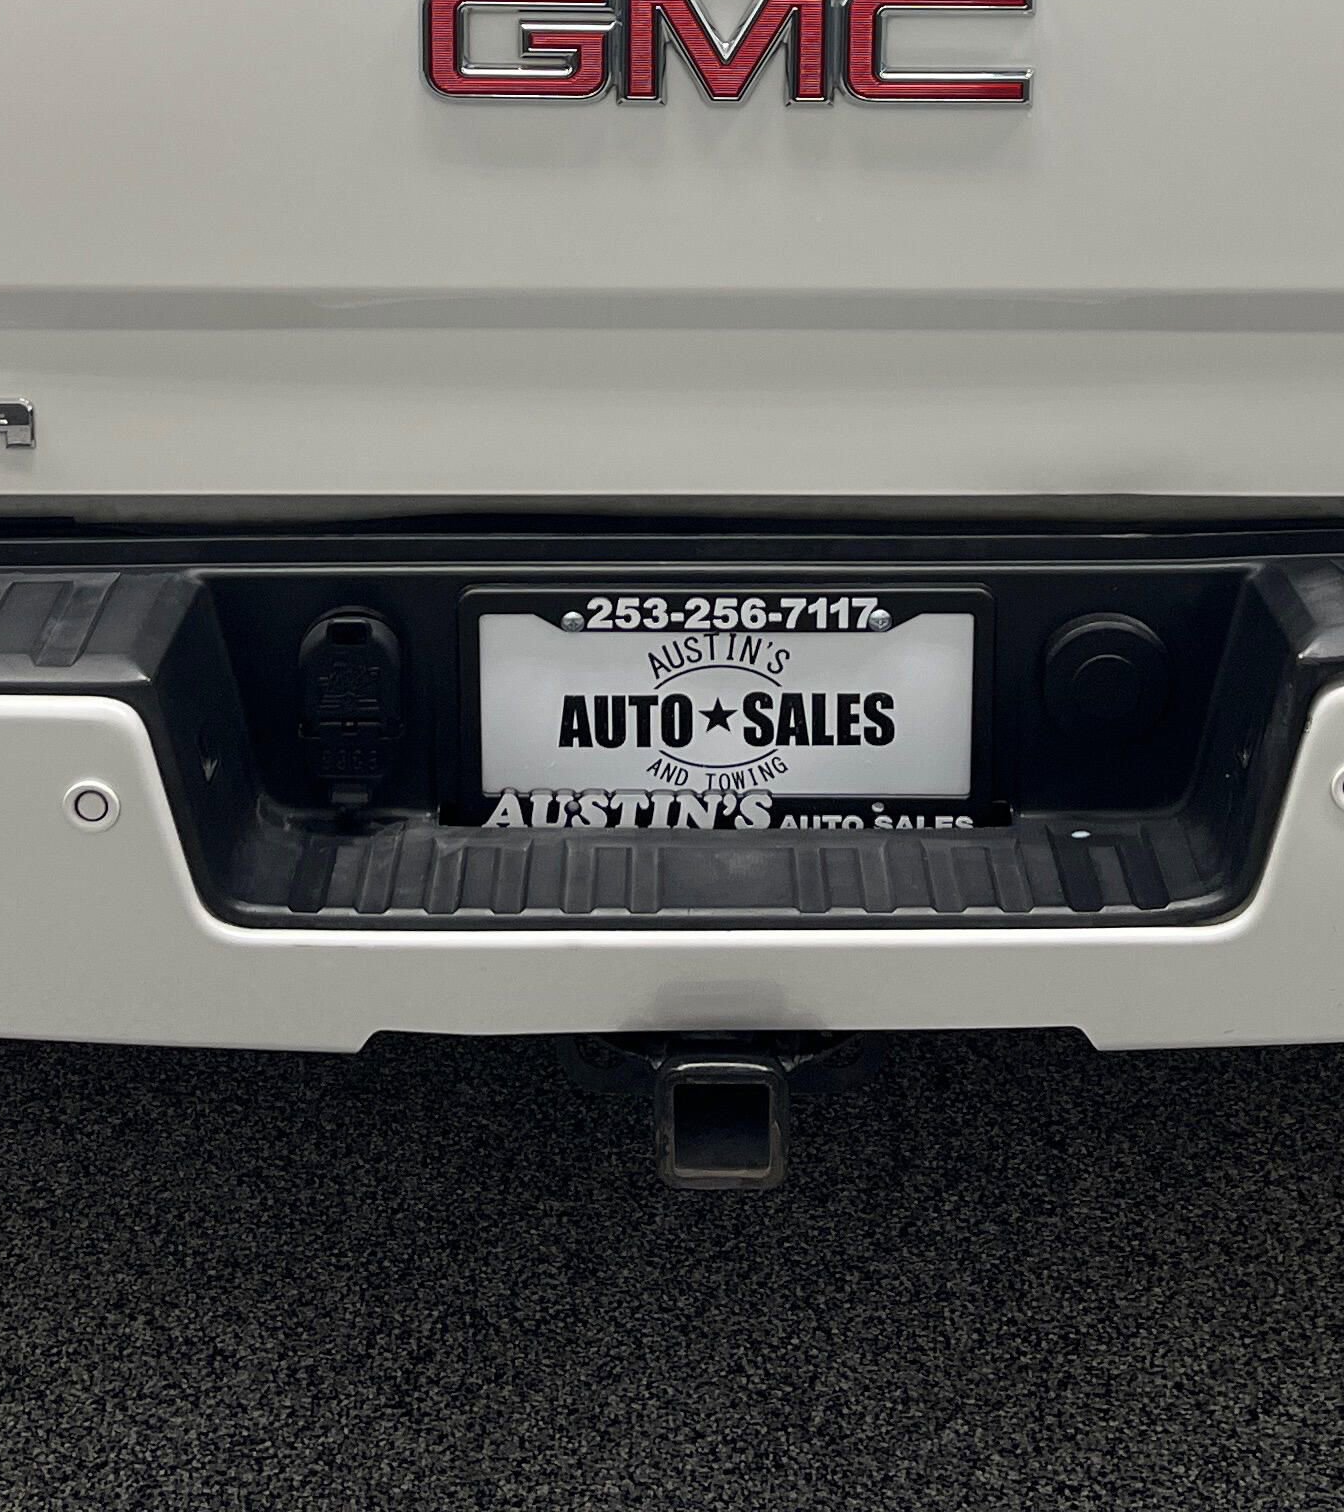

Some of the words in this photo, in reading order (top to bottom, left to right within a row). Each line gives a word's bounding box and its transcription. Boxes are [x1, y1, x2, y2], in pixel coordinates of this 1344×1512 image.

[586, 597, 879, 631] 253-256-7117
[647, 633, 791, 680] AUSTIN'S
[558, 694, 695, 749] AUTO
[742, 691, 896, 747] SALES
[646, 758, 690, 786] AND
[705, 756, 789, 792] TOWING
[481, 793, 773, 830] AUSTIN'S
